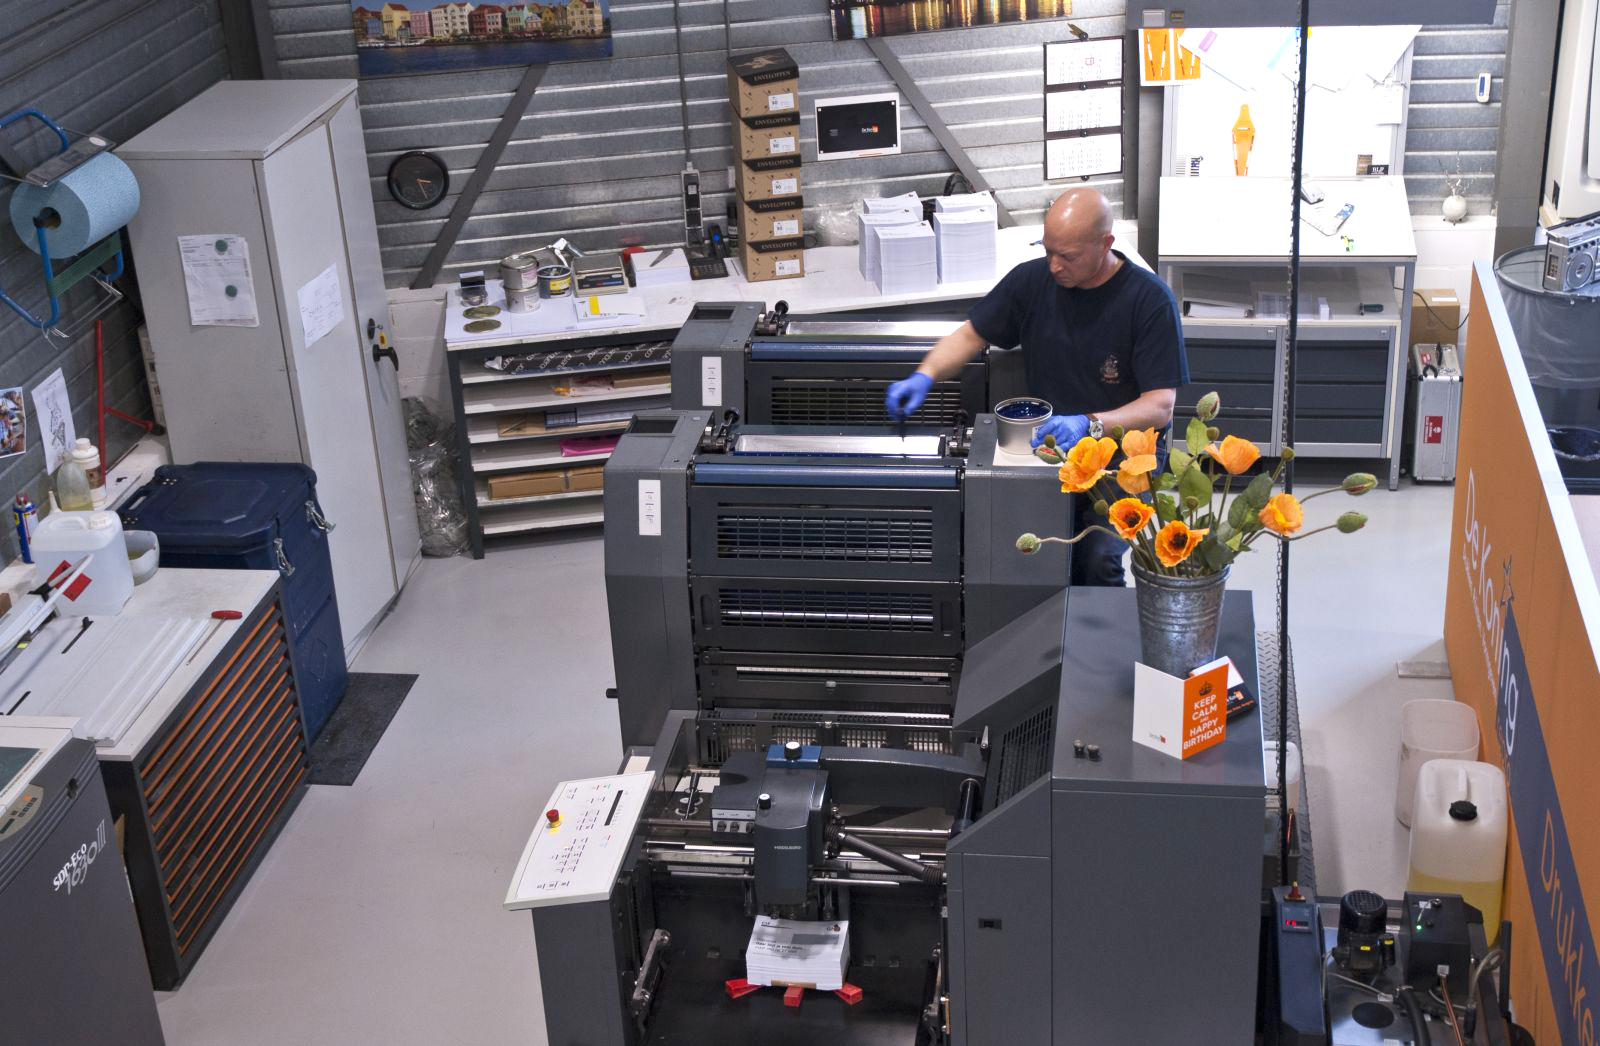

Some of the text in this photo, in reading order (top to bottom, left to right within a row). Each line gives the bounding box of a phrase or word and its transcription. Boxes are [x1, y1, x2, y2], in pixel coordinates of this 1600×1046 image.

[753, 69, 791, 82] ENVELOPPEN
[755, 116, 793, 127] ENVELOPPEN
[757, 158, 794, 169] ENVELOPPEN
[759, 200, 796, 210] ENVELOPPEN
[761, 241, 798, 251] ENVELOPPEN
[1464, 467, 1479, 571] De
[1479, 524, 1519, 756] Koning
[1194, 694, 1217, 711] KEEP
[1191, 703, 1218, 721] CALM
[1189, 717, 1219, 737] HAPPY
[1183, 724, 1225, 750] BIRTHDAY
[1541, 807, 1600, 1046] Drukke
